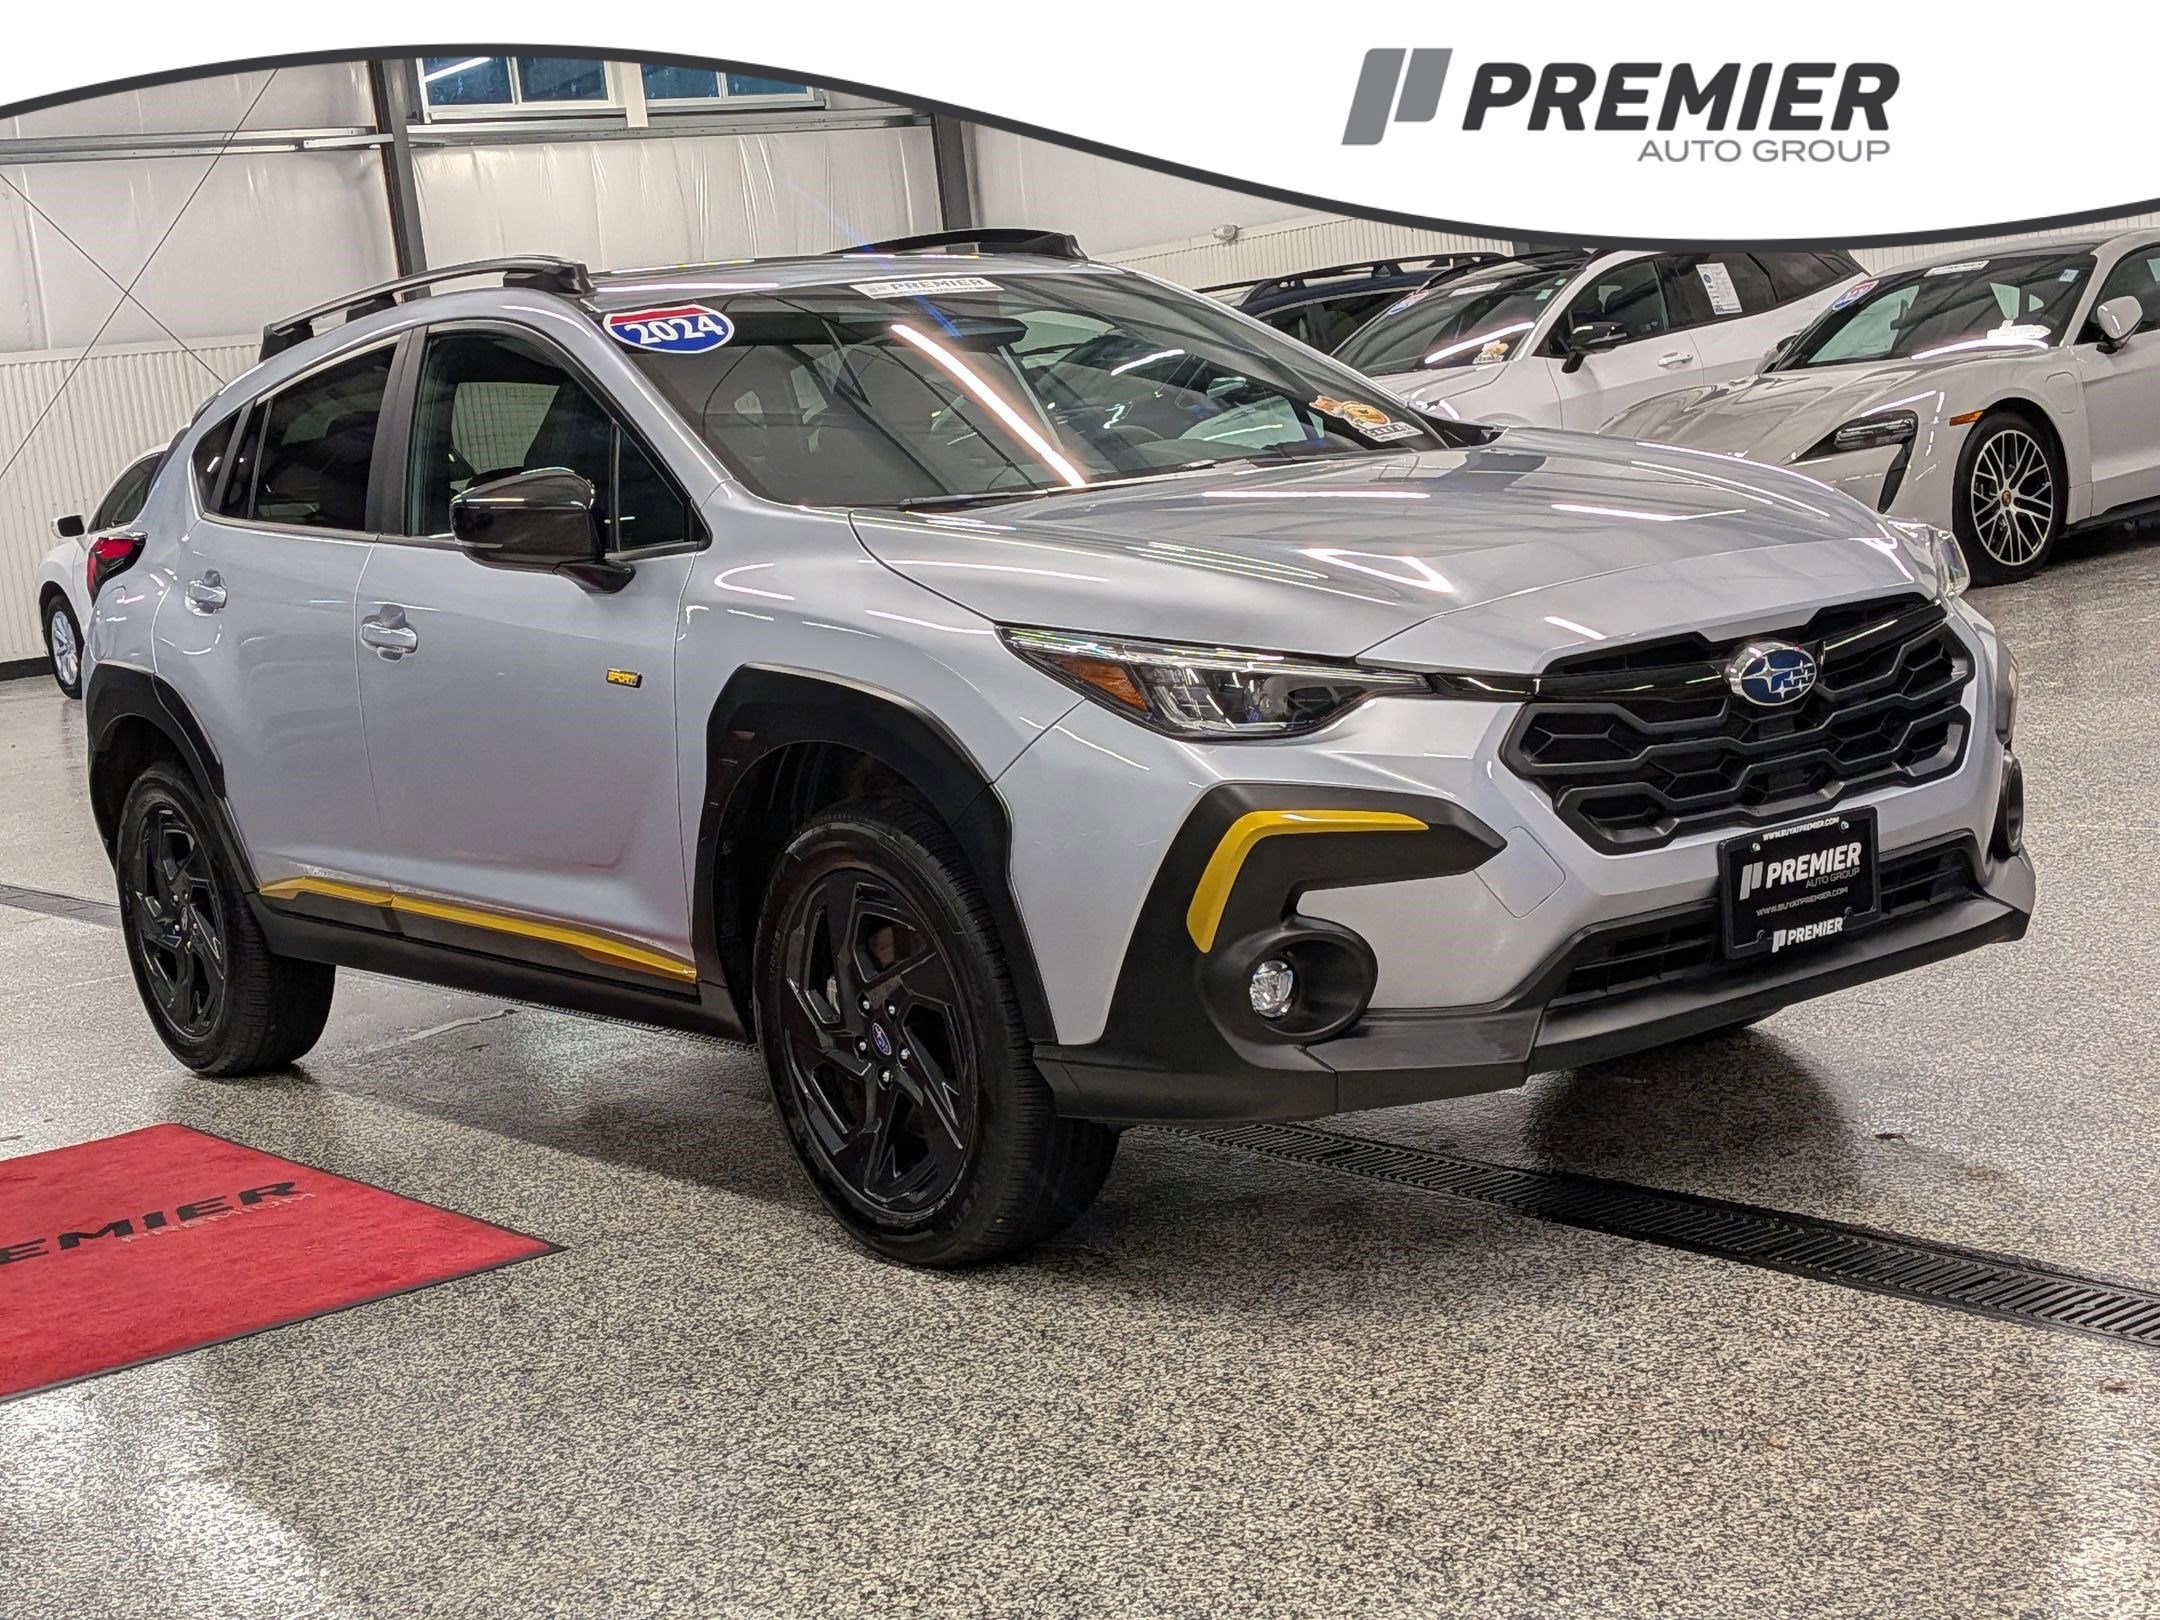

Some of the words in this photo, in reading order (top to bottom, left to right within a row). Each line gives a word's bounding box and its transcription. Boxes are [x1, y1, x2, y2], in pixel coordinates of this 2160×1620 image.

[889, 278, 985, 291] PREMIER
[623, 315, 726, 345] 2024
[1765, 842, 1862, 889] PREMIER
[1805, 874, 1829, 889] AUTO
[1829, 866, 1861, 883] GROUP
[1787, 916, 1844, 946] PREMIER
